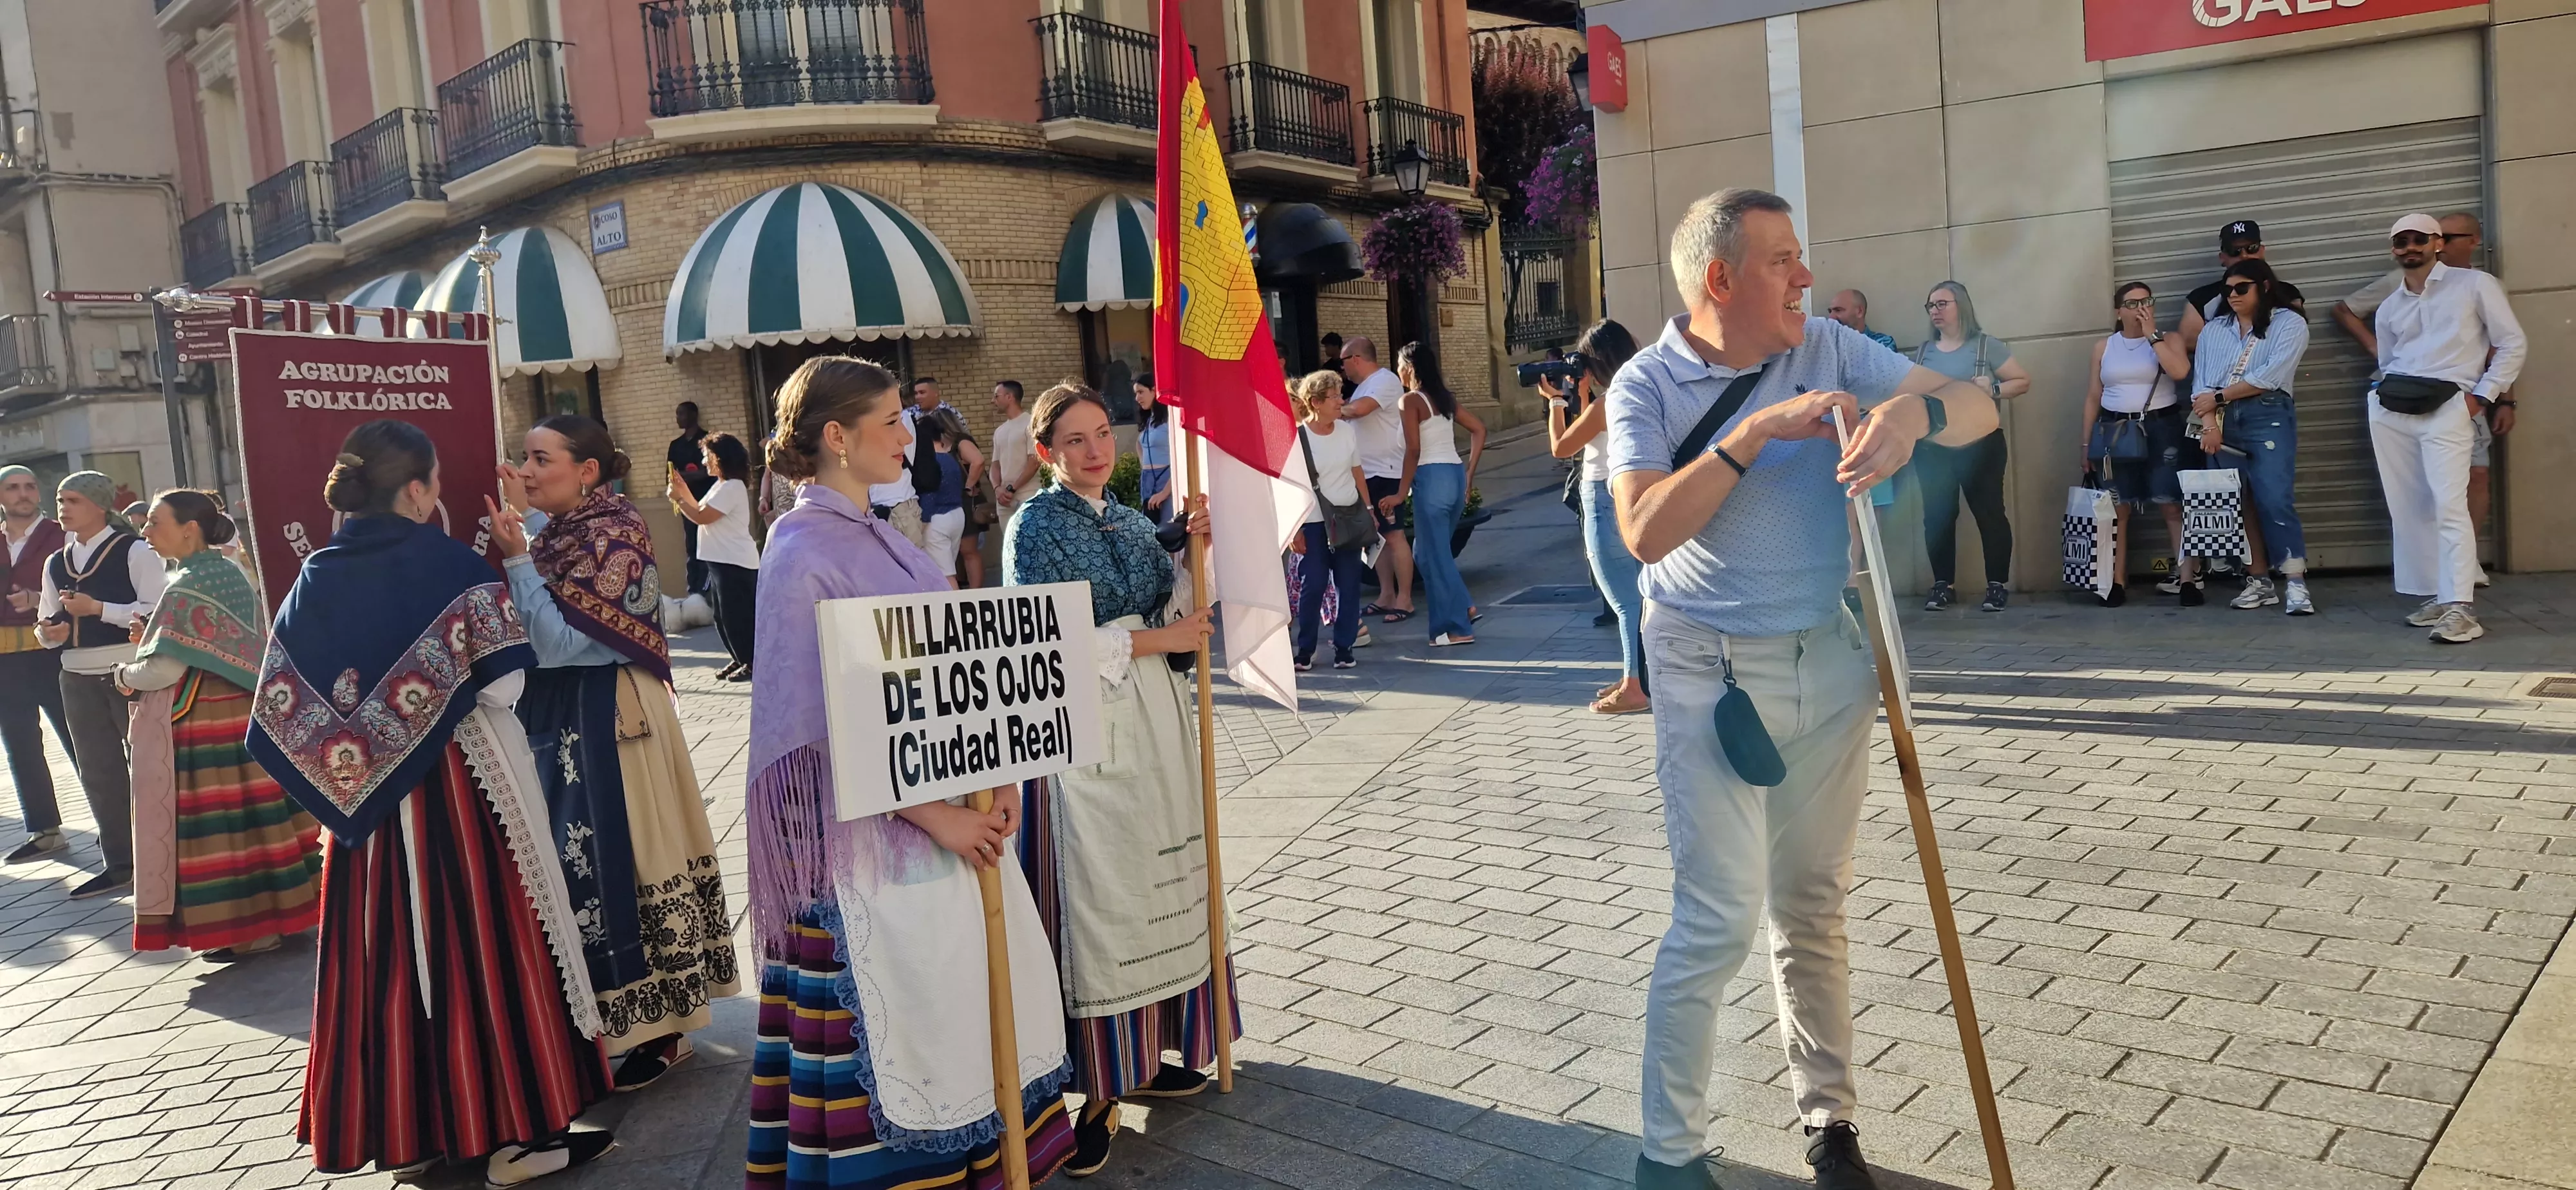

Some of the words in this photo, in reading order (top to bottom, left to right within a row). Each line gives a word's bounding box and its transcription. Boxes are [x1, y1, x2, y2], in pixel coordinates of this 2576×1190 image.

[1607, 52, 1622, 78] GAES
[601, 211, 618, 224] COSO
[2233, 222, 2246, 234] NY
[597, 232, 621, 246] ALTO
[278, 359, 450, 384] AGRUPACIÓN
[283, 388, 453, 411] FOLKLÓRICA
[2192, 515, 2231, 529] ALMI
[873, 595, 1062, 661] VILLARRUBIA
[882, 668, 926, 725] DE
[932, 659, 989, 717] LOS
[996, 650, 1066, 707] OJOS
[889, 718, 1001, 802] (Ciudad
[1007, 706, 1073, 764] Real)
